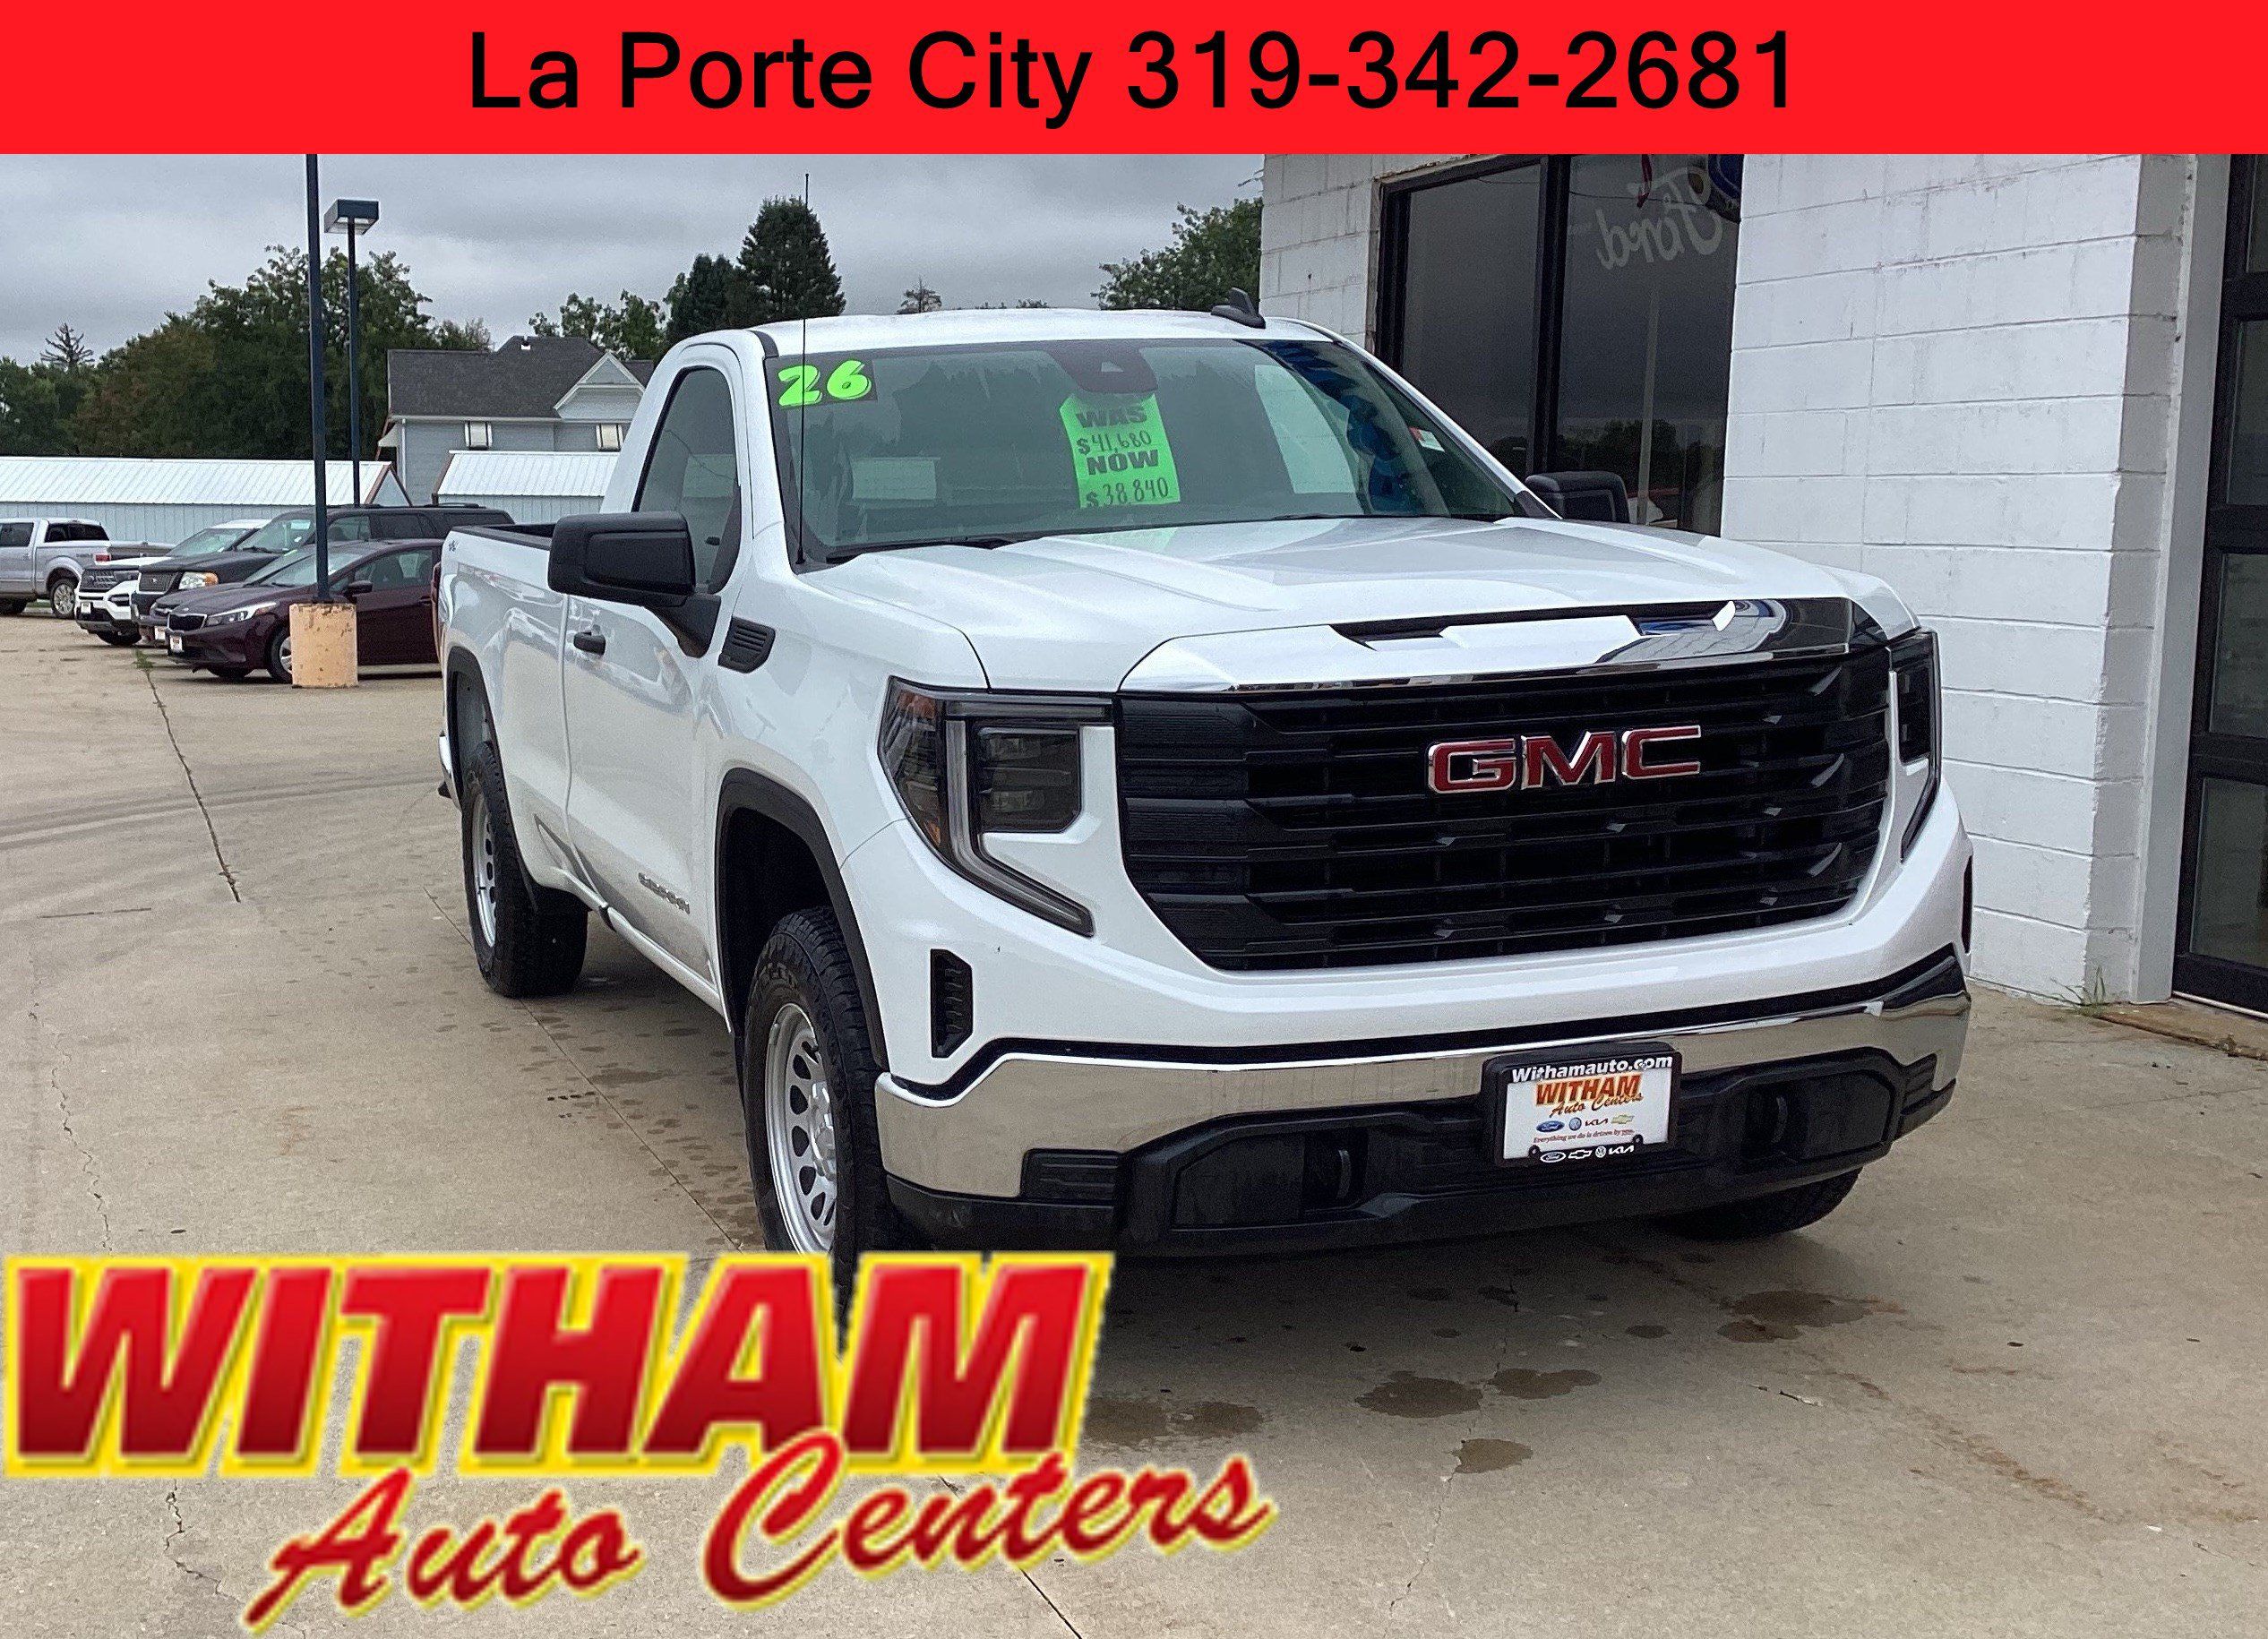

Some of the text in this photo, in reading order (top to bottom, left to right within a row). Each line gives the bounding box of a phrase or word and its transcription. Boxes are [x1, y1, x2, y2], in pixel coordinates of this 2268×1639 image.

[777, 359, 872, 407] 26
[1076, 404, 1147, 428] WAS
[1087, 449, 1159, 476] NOW
[1428, 725, 1701, 794] GMC
[1512, 1056, 1673, 1084] Withamauto.com
[1535, 1074, 1643, 1106] WITHAM
[1549, 1099, 1586, 1118] Auto
